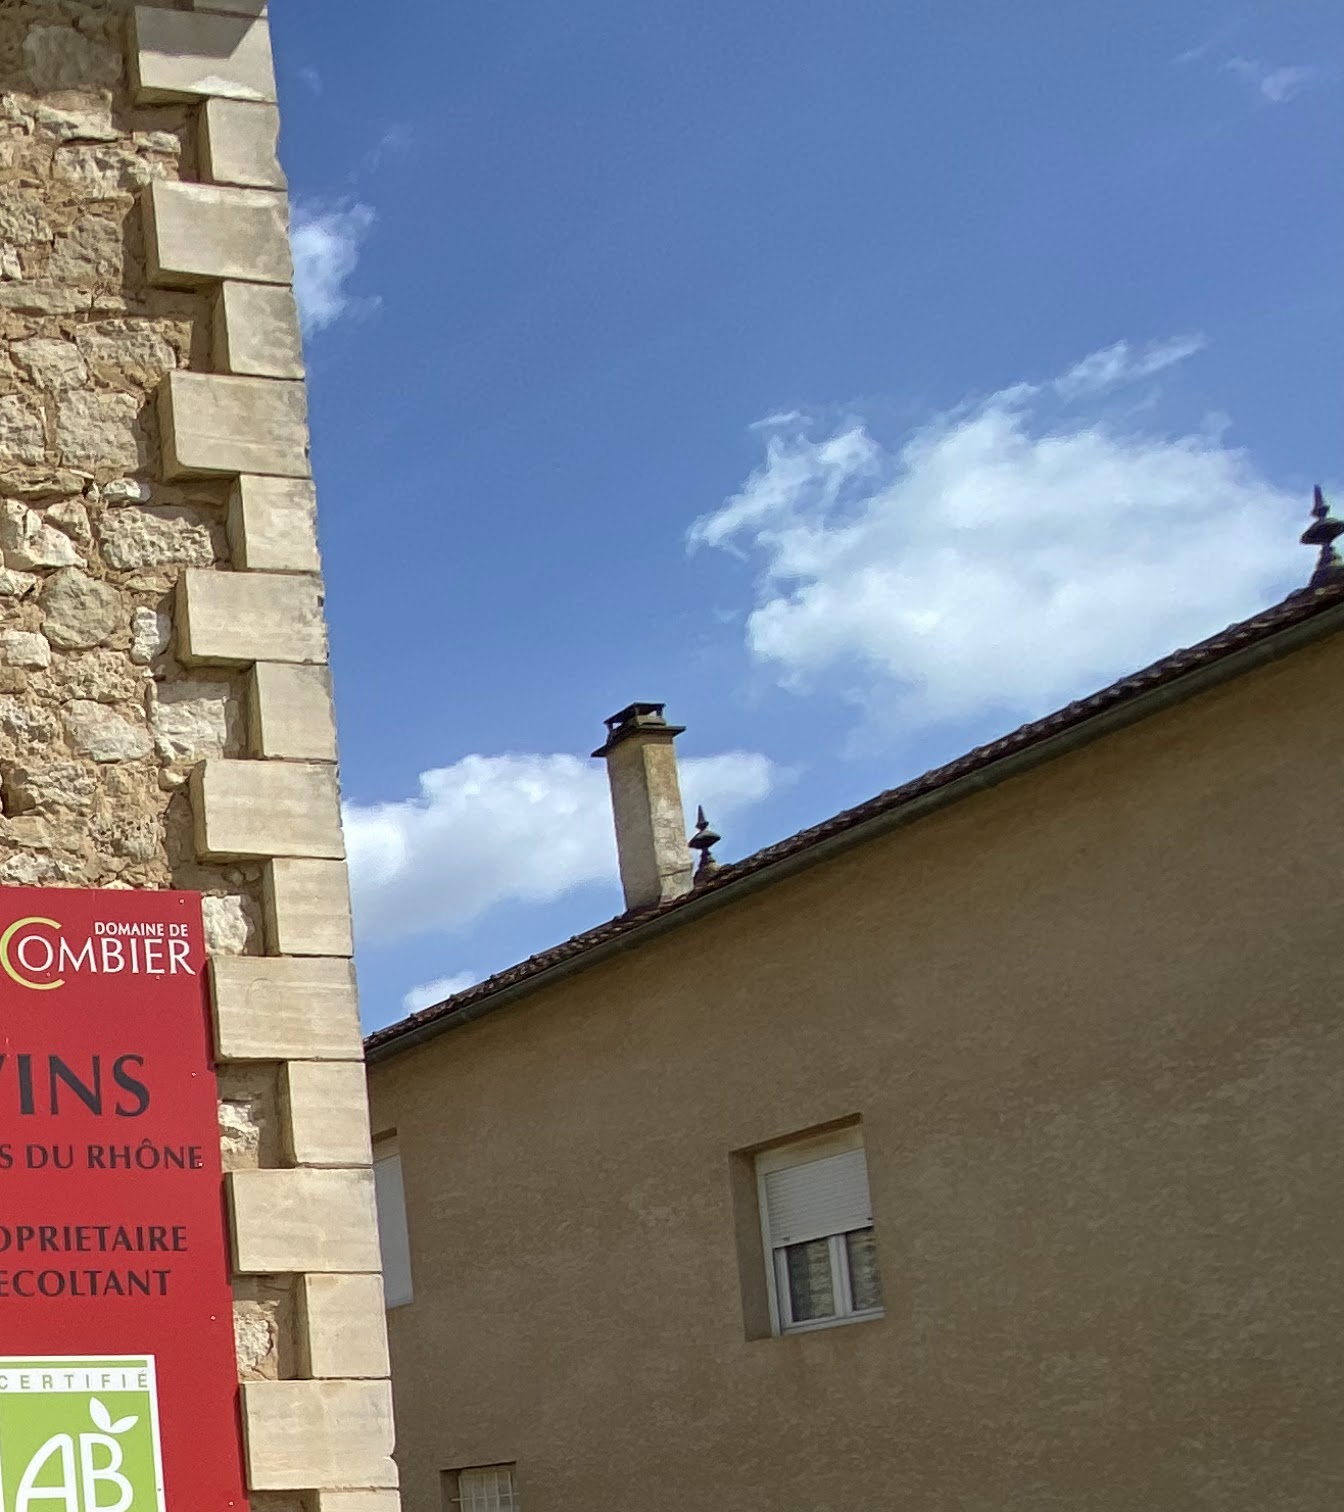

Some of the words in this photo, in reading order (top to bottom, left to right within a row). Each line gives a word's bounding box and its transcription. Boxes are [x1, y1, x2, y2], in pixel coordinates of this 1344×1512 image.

[94, 921, 165, 937] DOMAINE
[169, 923, 188, 938] DE
[25, 1144, 74, 1170] DU
[87, 1138, 203, 1170] RHÔNE
